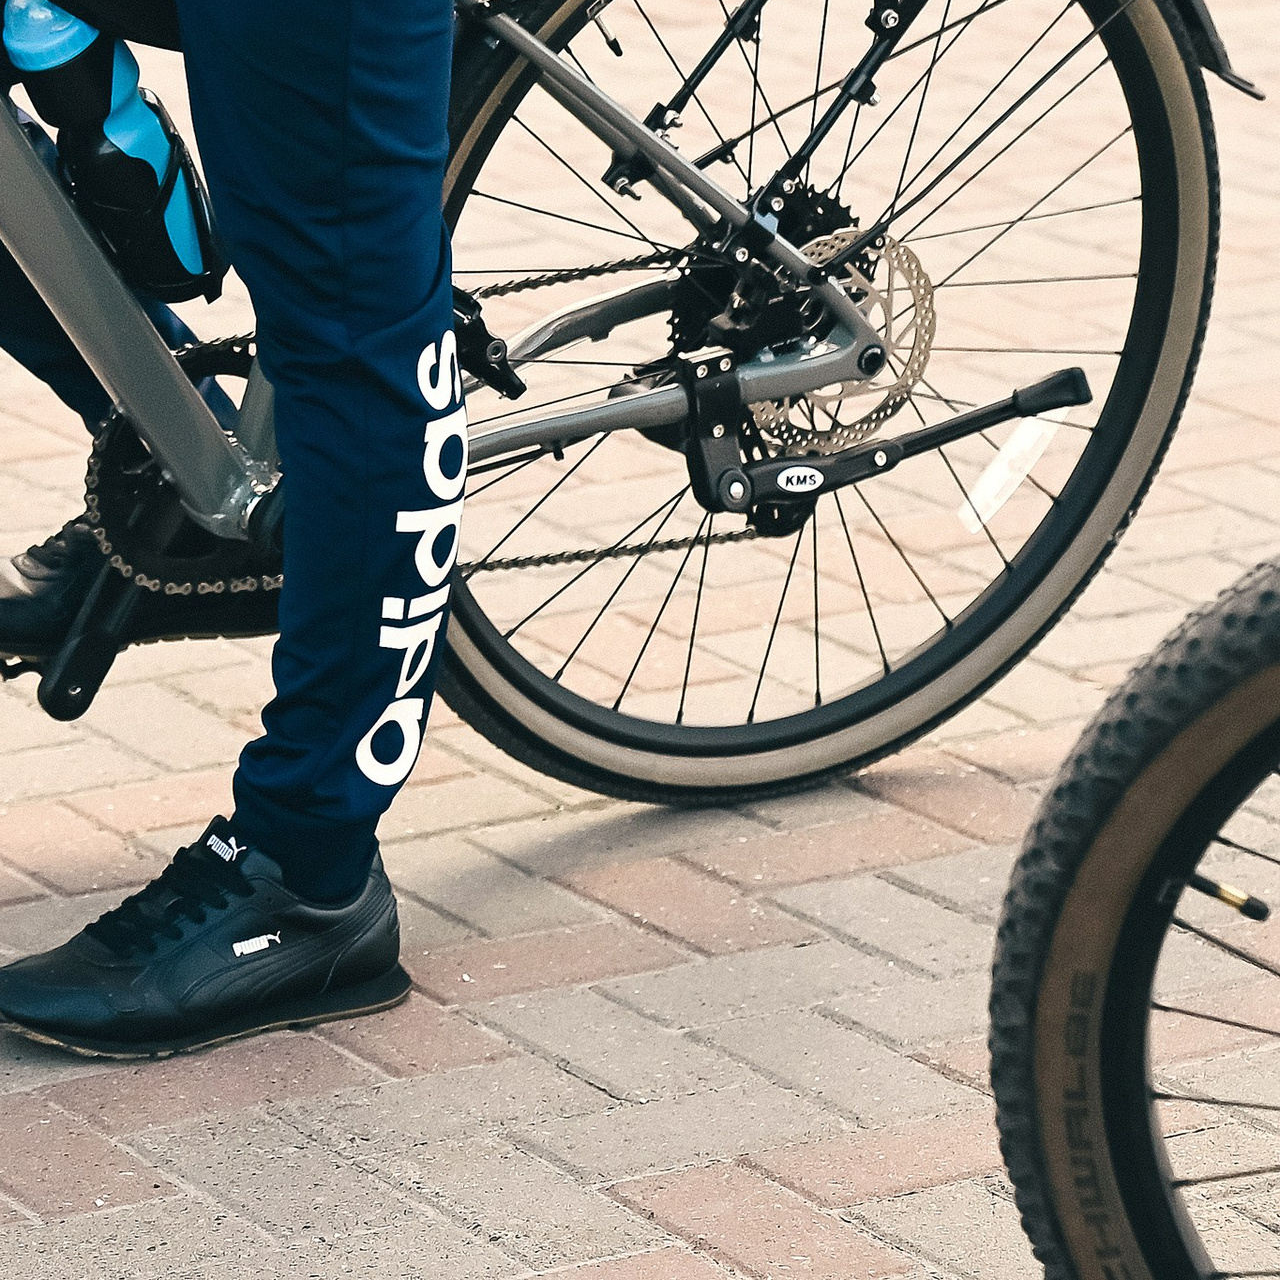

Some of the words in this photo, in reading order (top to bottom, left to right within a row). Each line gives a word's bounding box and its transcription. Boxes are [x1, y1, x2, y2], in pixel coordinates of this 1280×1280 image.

[785, 474, 817, 487] KMS
[355, 329, 468, 786] adidas
[206, 834, 234, 862] PUMA
